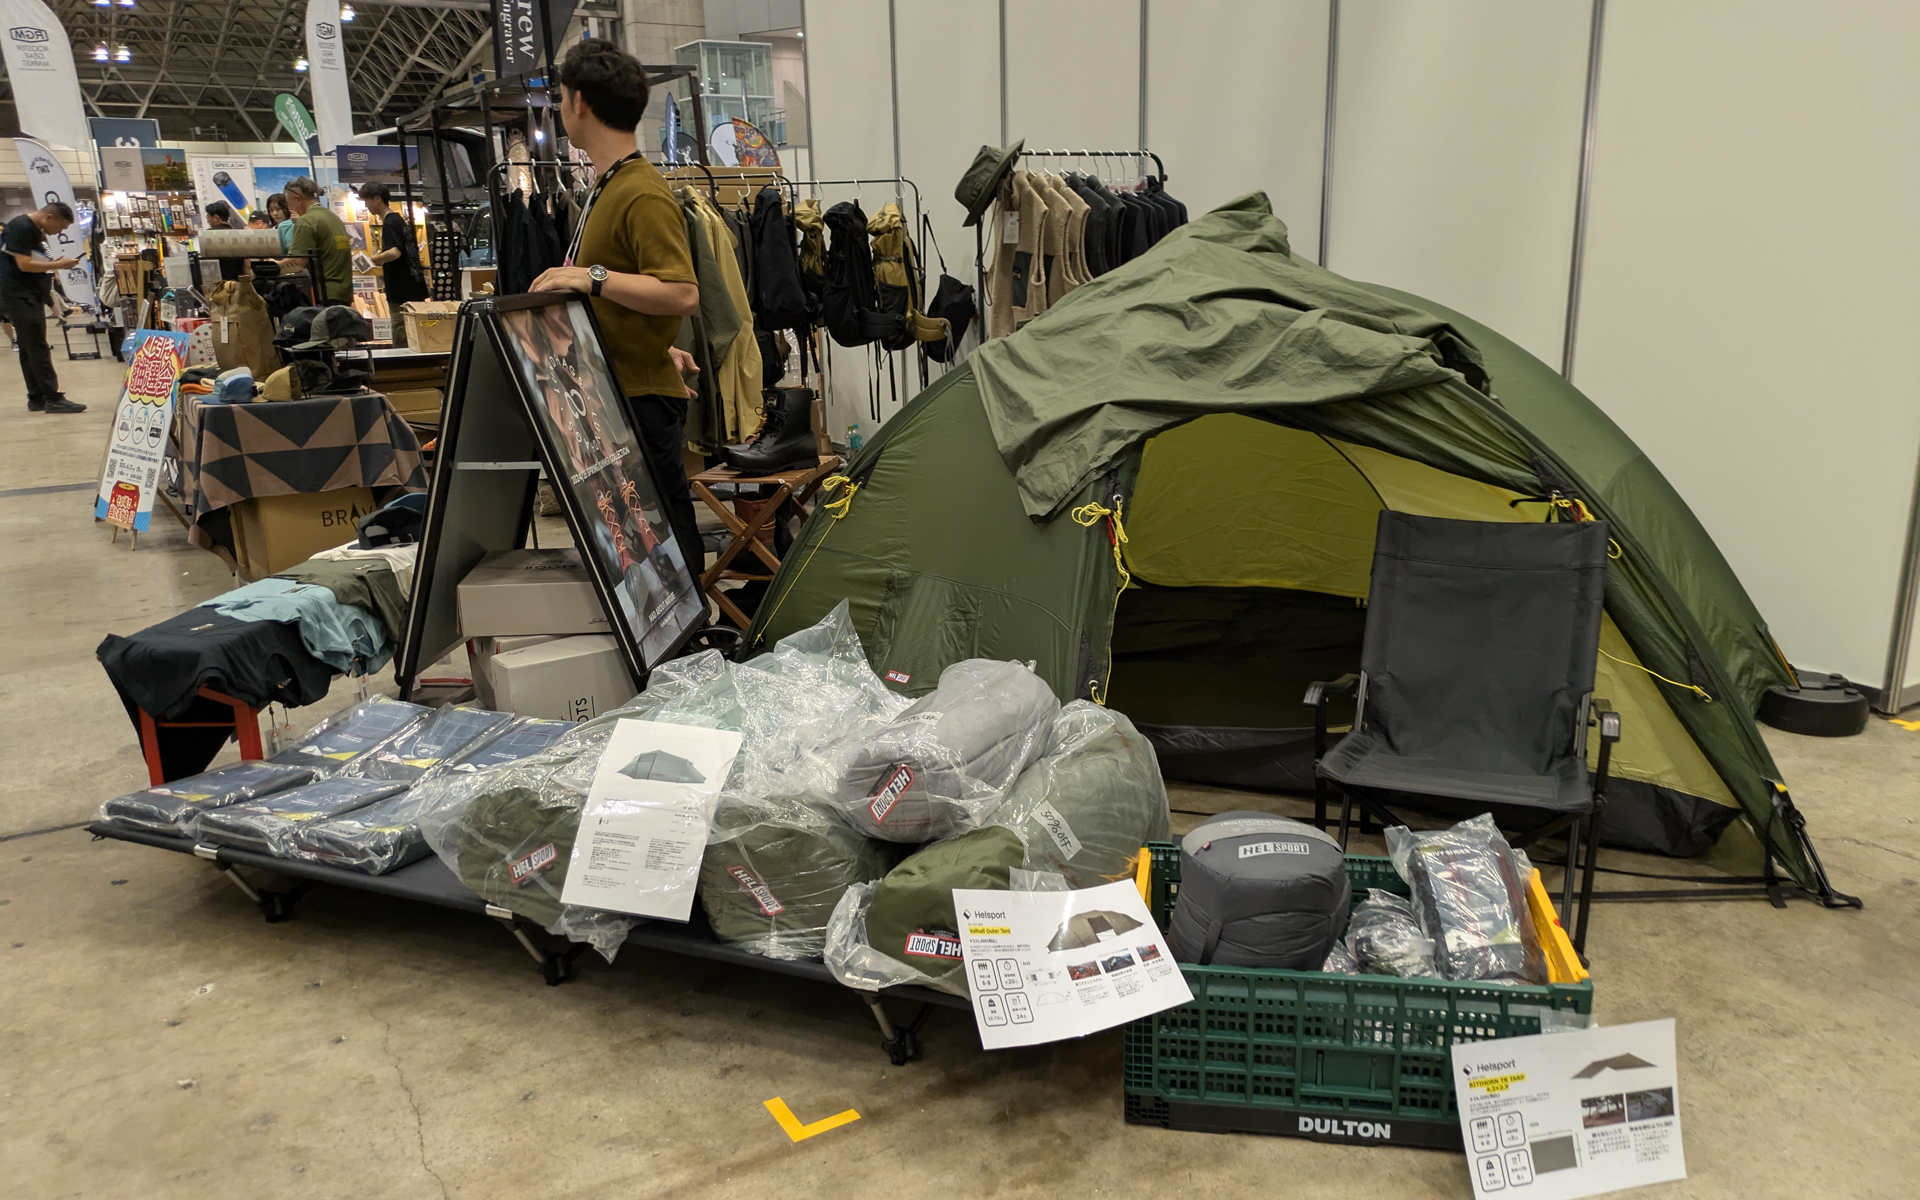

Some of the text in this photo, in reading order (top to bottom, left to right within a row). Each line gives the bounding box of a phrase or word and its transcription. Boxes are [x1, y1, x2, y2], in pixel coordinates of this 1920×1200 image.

[142, 335, 175, 360] くじ引き
[873, 769, 911, 818] HEL SPORT
[1243, 843, 1308, 856] HEL SPORT
[512, 845, 554, 879] HEL SPORT
[733, 869, 780, 911] HEL SPORT
[974, 910, 1007, 920] Helsport
[910, 937, 937, 953] SPORT
[939, 940, 962, 957] HEL
[1477, 1059, 1516, 1074] Helsport
[1298, 1116, 1392, 1139] DULTON
